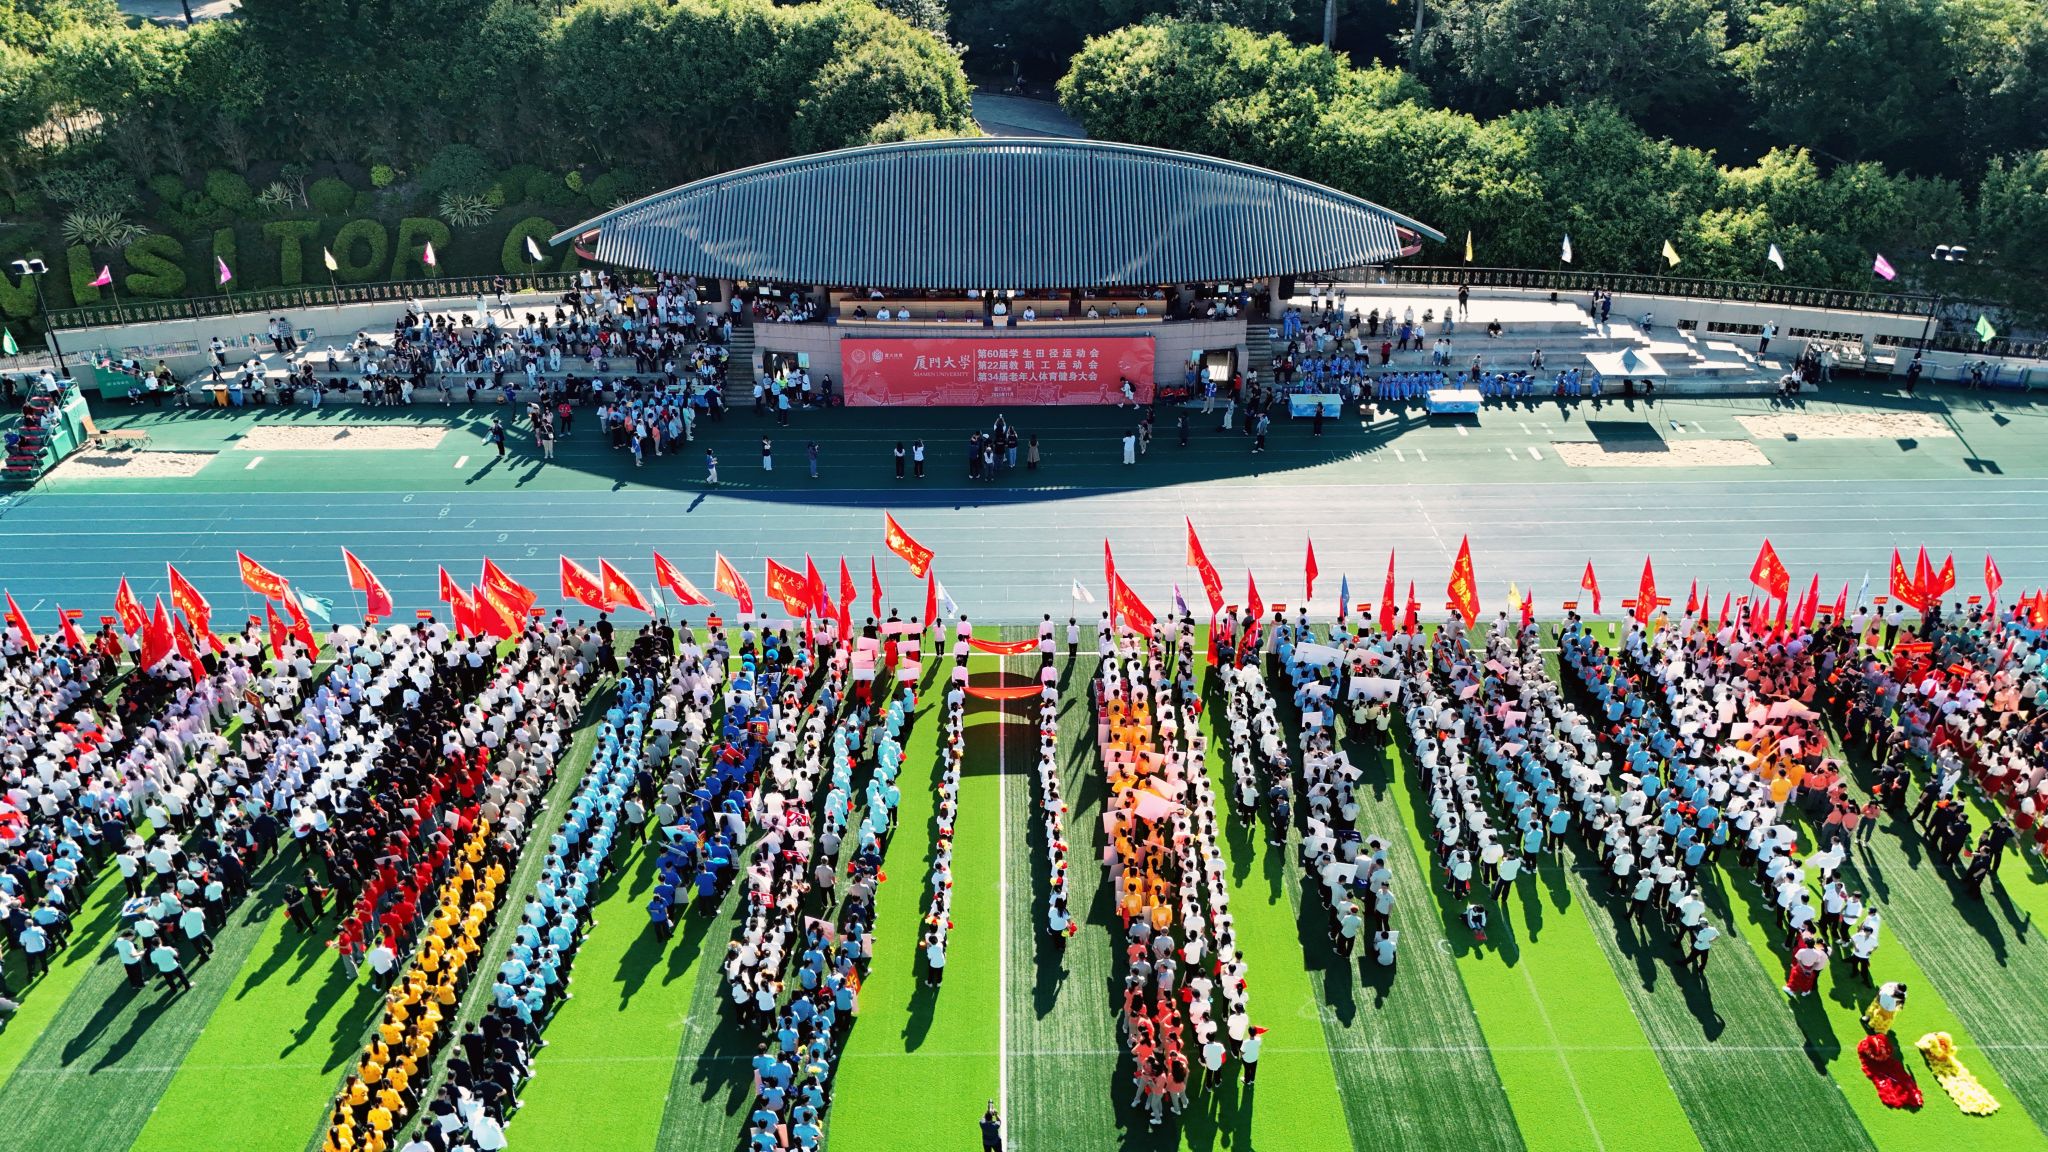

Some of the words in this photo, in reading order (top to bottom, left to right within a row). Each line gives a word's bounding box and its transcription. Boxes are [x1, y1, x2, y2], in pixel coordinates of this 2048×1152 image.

[977, 348, 1100, 359] 第60届学生田径运动会
[977, 360, 1099, 370] 第22届教职工运动会
[977, 371, 1098, 382] 第34届老年人体育健身大会
